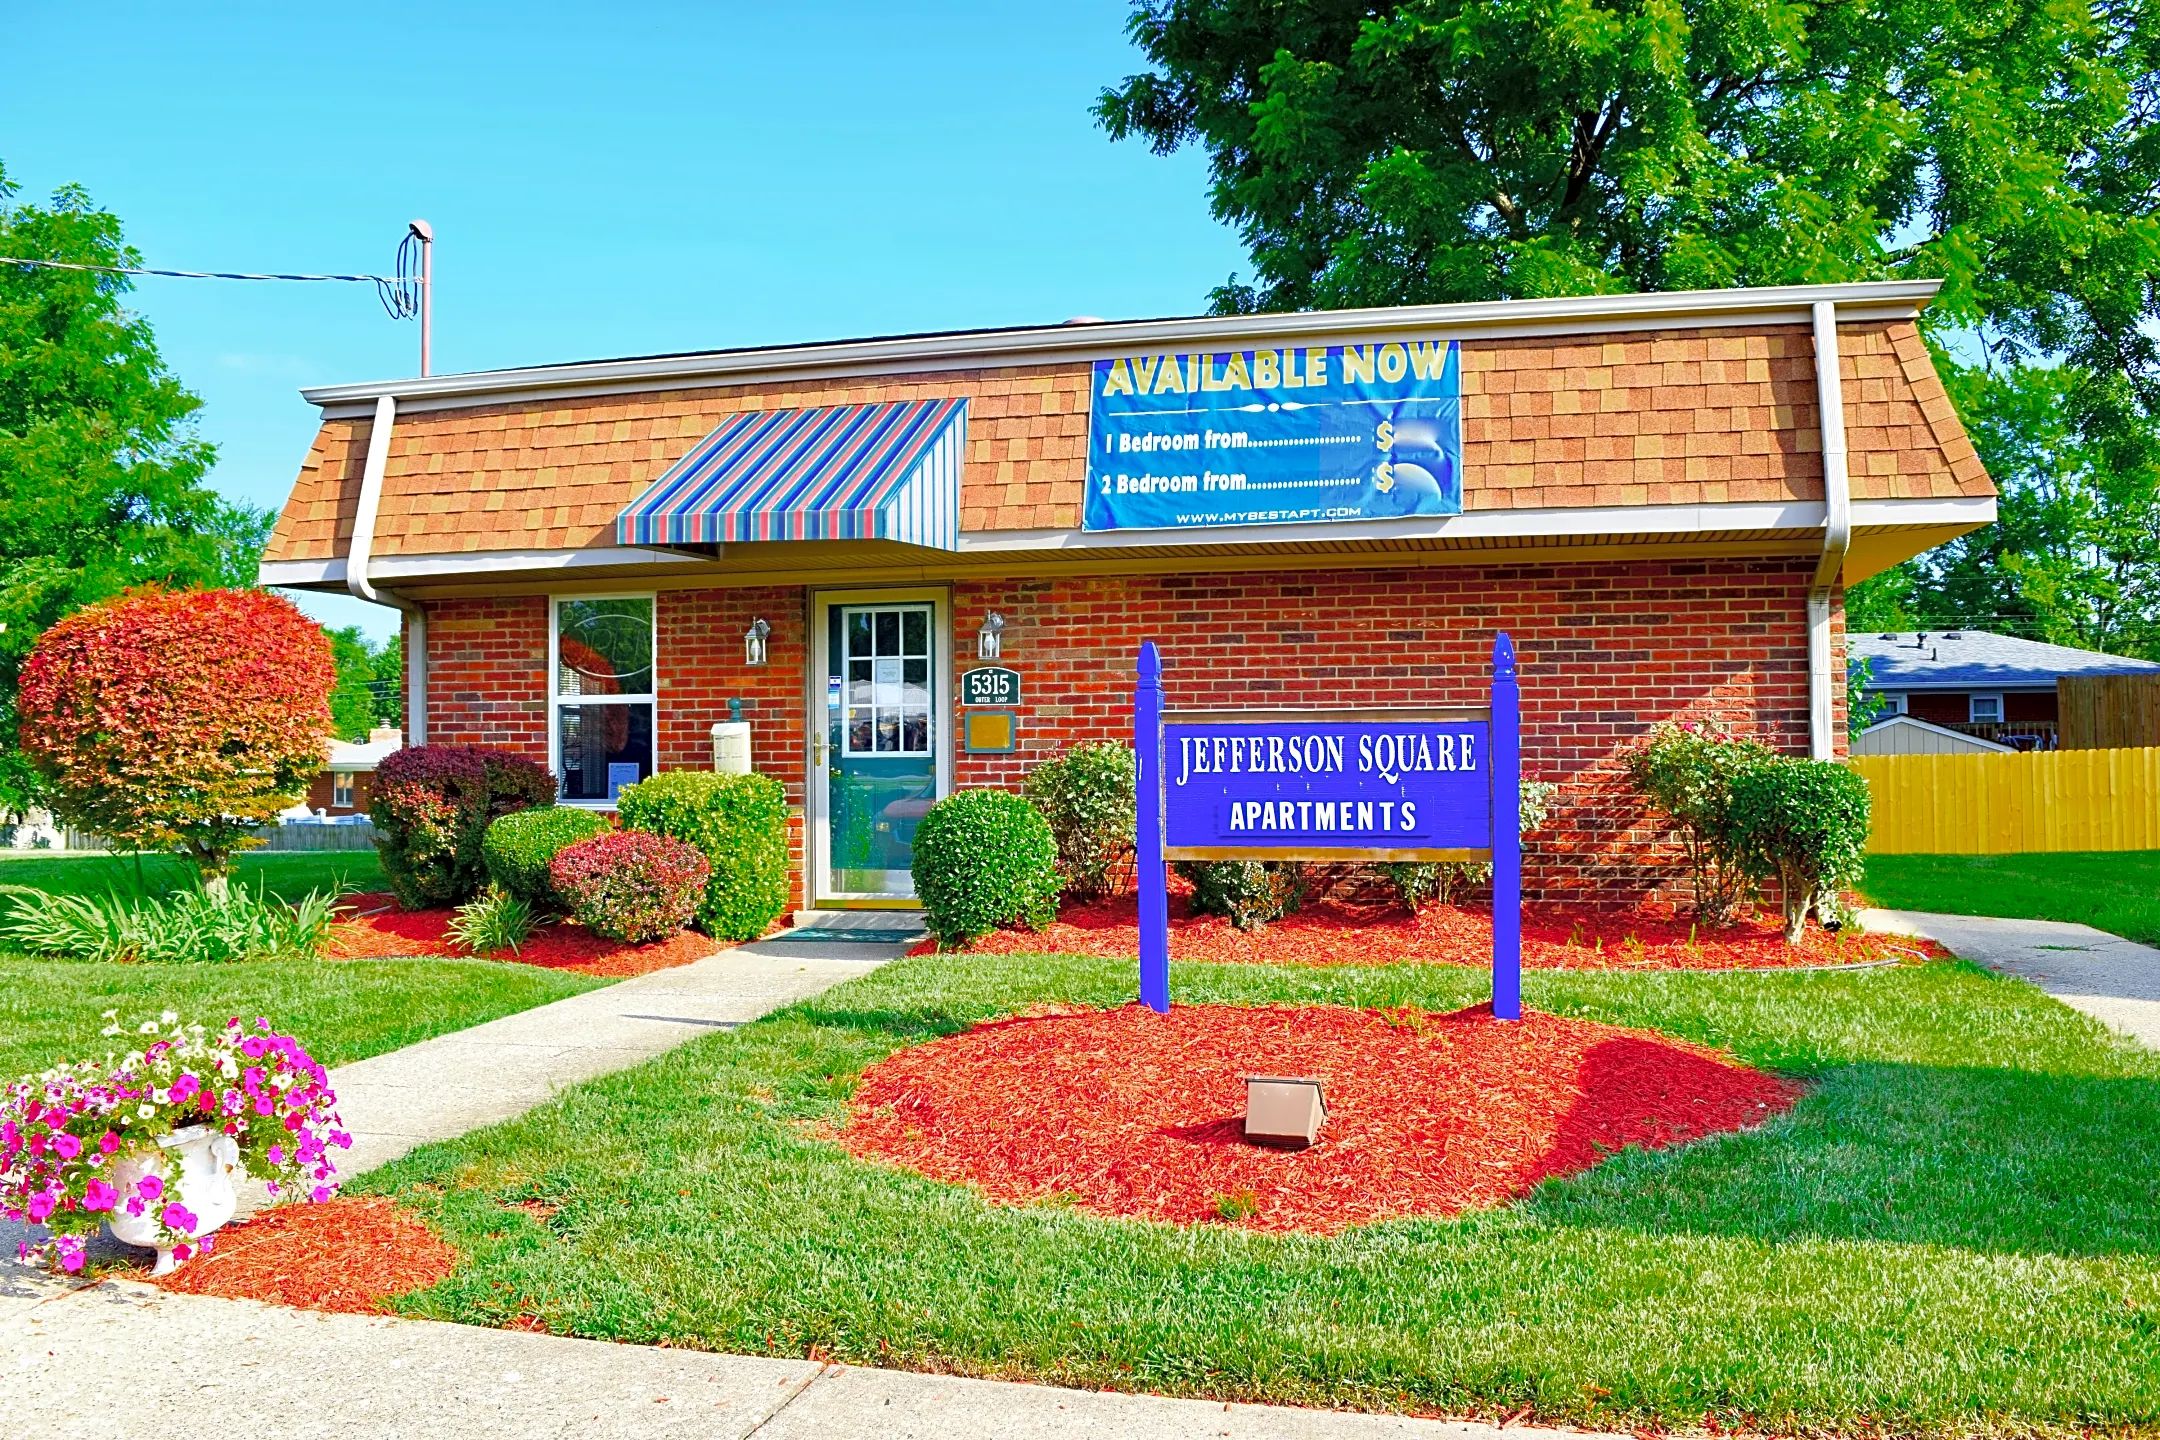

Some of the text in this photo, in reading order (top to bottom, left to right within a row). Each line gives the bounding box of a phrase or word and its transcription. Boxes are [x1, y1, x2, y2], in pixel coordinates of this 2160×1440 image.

[1102, 340, 1450, 397] AVAILABLE NOW
[1105, 433, 1112, 453] 1
[1119, 432, 1200, 453] Bedroom
[1101, 474, 1111, 494] 2
[1116, 473, 1198, 494] Bedroom
[1176, 507, 1362, 524] WWW.MYBESTAPT.COM
[971, 674, 1010, 695] 5315
[1176, 734, 1476, 787] JEFFERSON SQUARE
[1229, 801, 1416, 831] APARTMENTS
